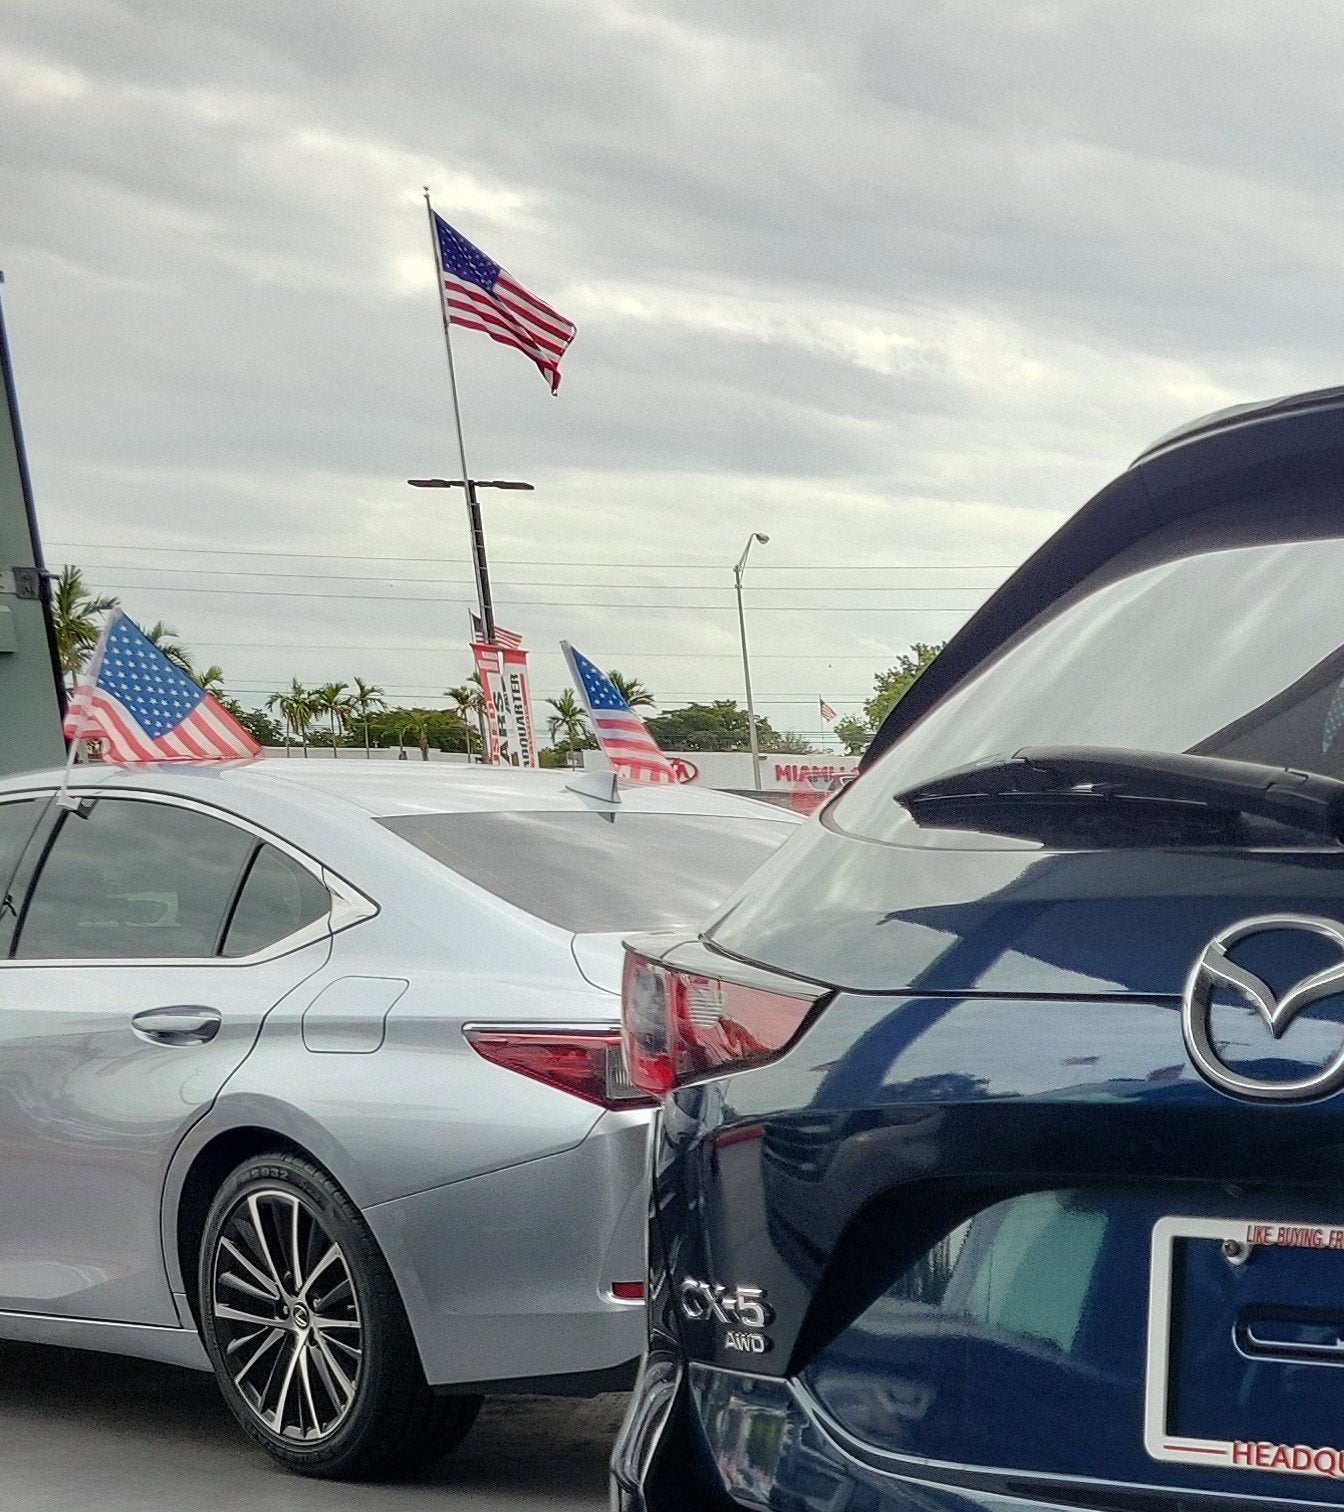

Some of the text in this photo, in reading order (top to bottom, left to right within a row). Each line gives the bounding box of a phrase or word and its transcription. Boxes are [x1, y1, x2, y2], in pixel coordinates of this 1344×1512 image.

[493, 691, 510, 764] ARS
[1247, 1225, 1272, 1244] LIKE
[1278, 1227, 1323, 1249] BUYING
[724, 1331, 765, 1354] AWD
